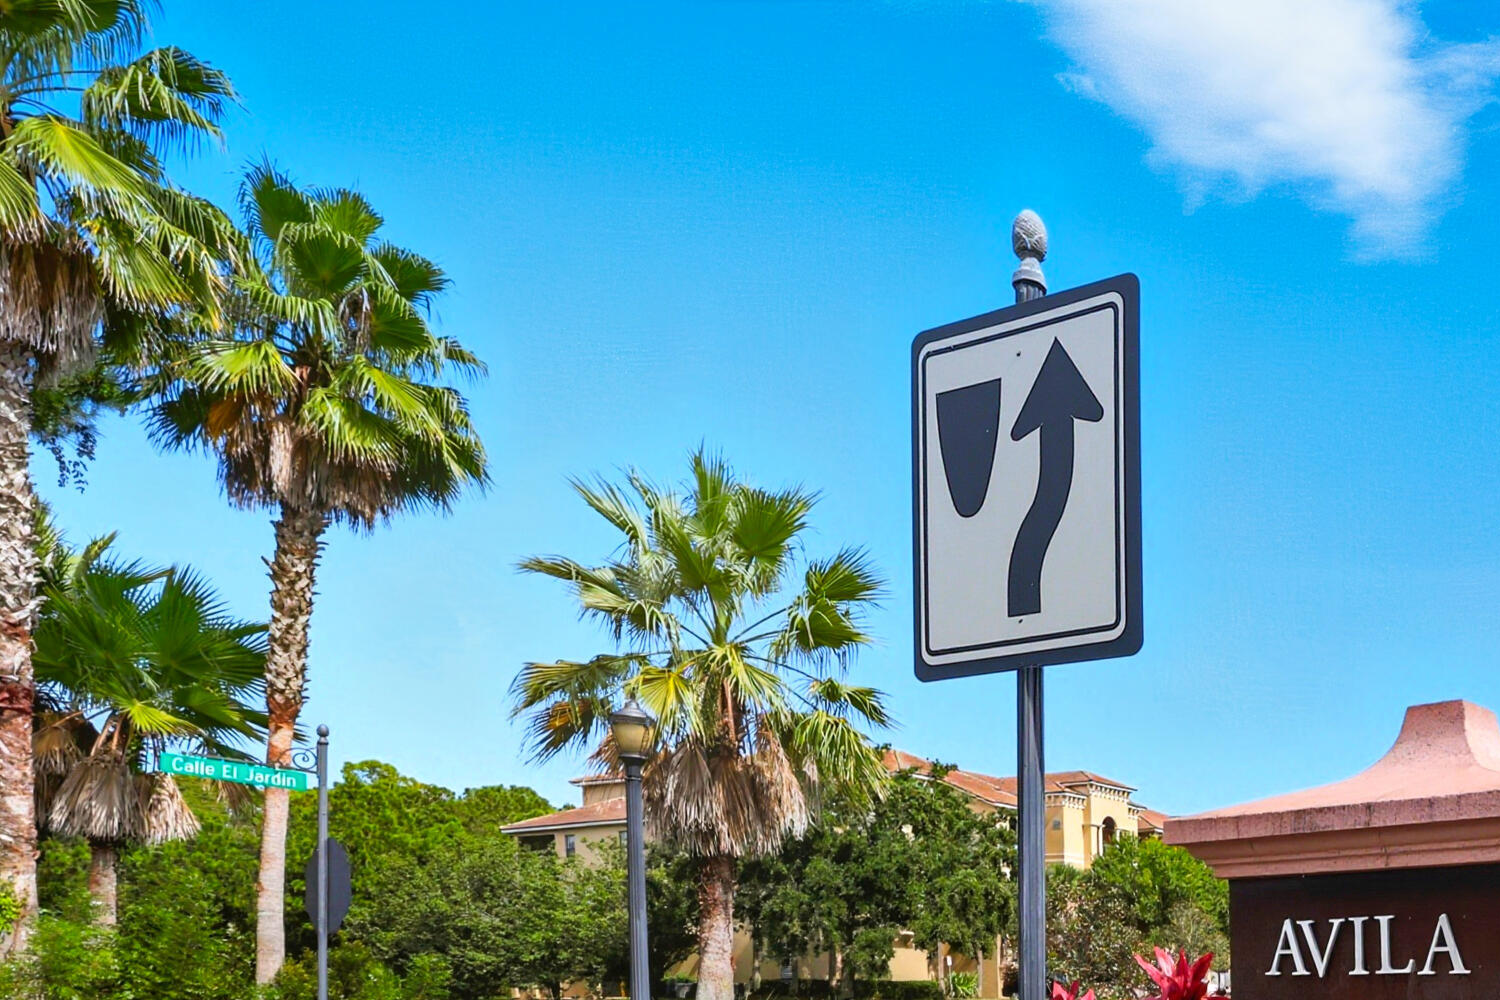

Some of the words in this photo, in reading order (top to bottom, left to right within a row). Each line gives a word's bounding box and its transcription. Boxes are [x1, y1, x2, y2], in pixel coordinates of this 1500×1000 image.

[171, 757, 216, 777] Calle
[222, 766, 238, 780] El
[245, 768, 297, 788] Jardin
[1265, 913, 1471, 979] AVILA
